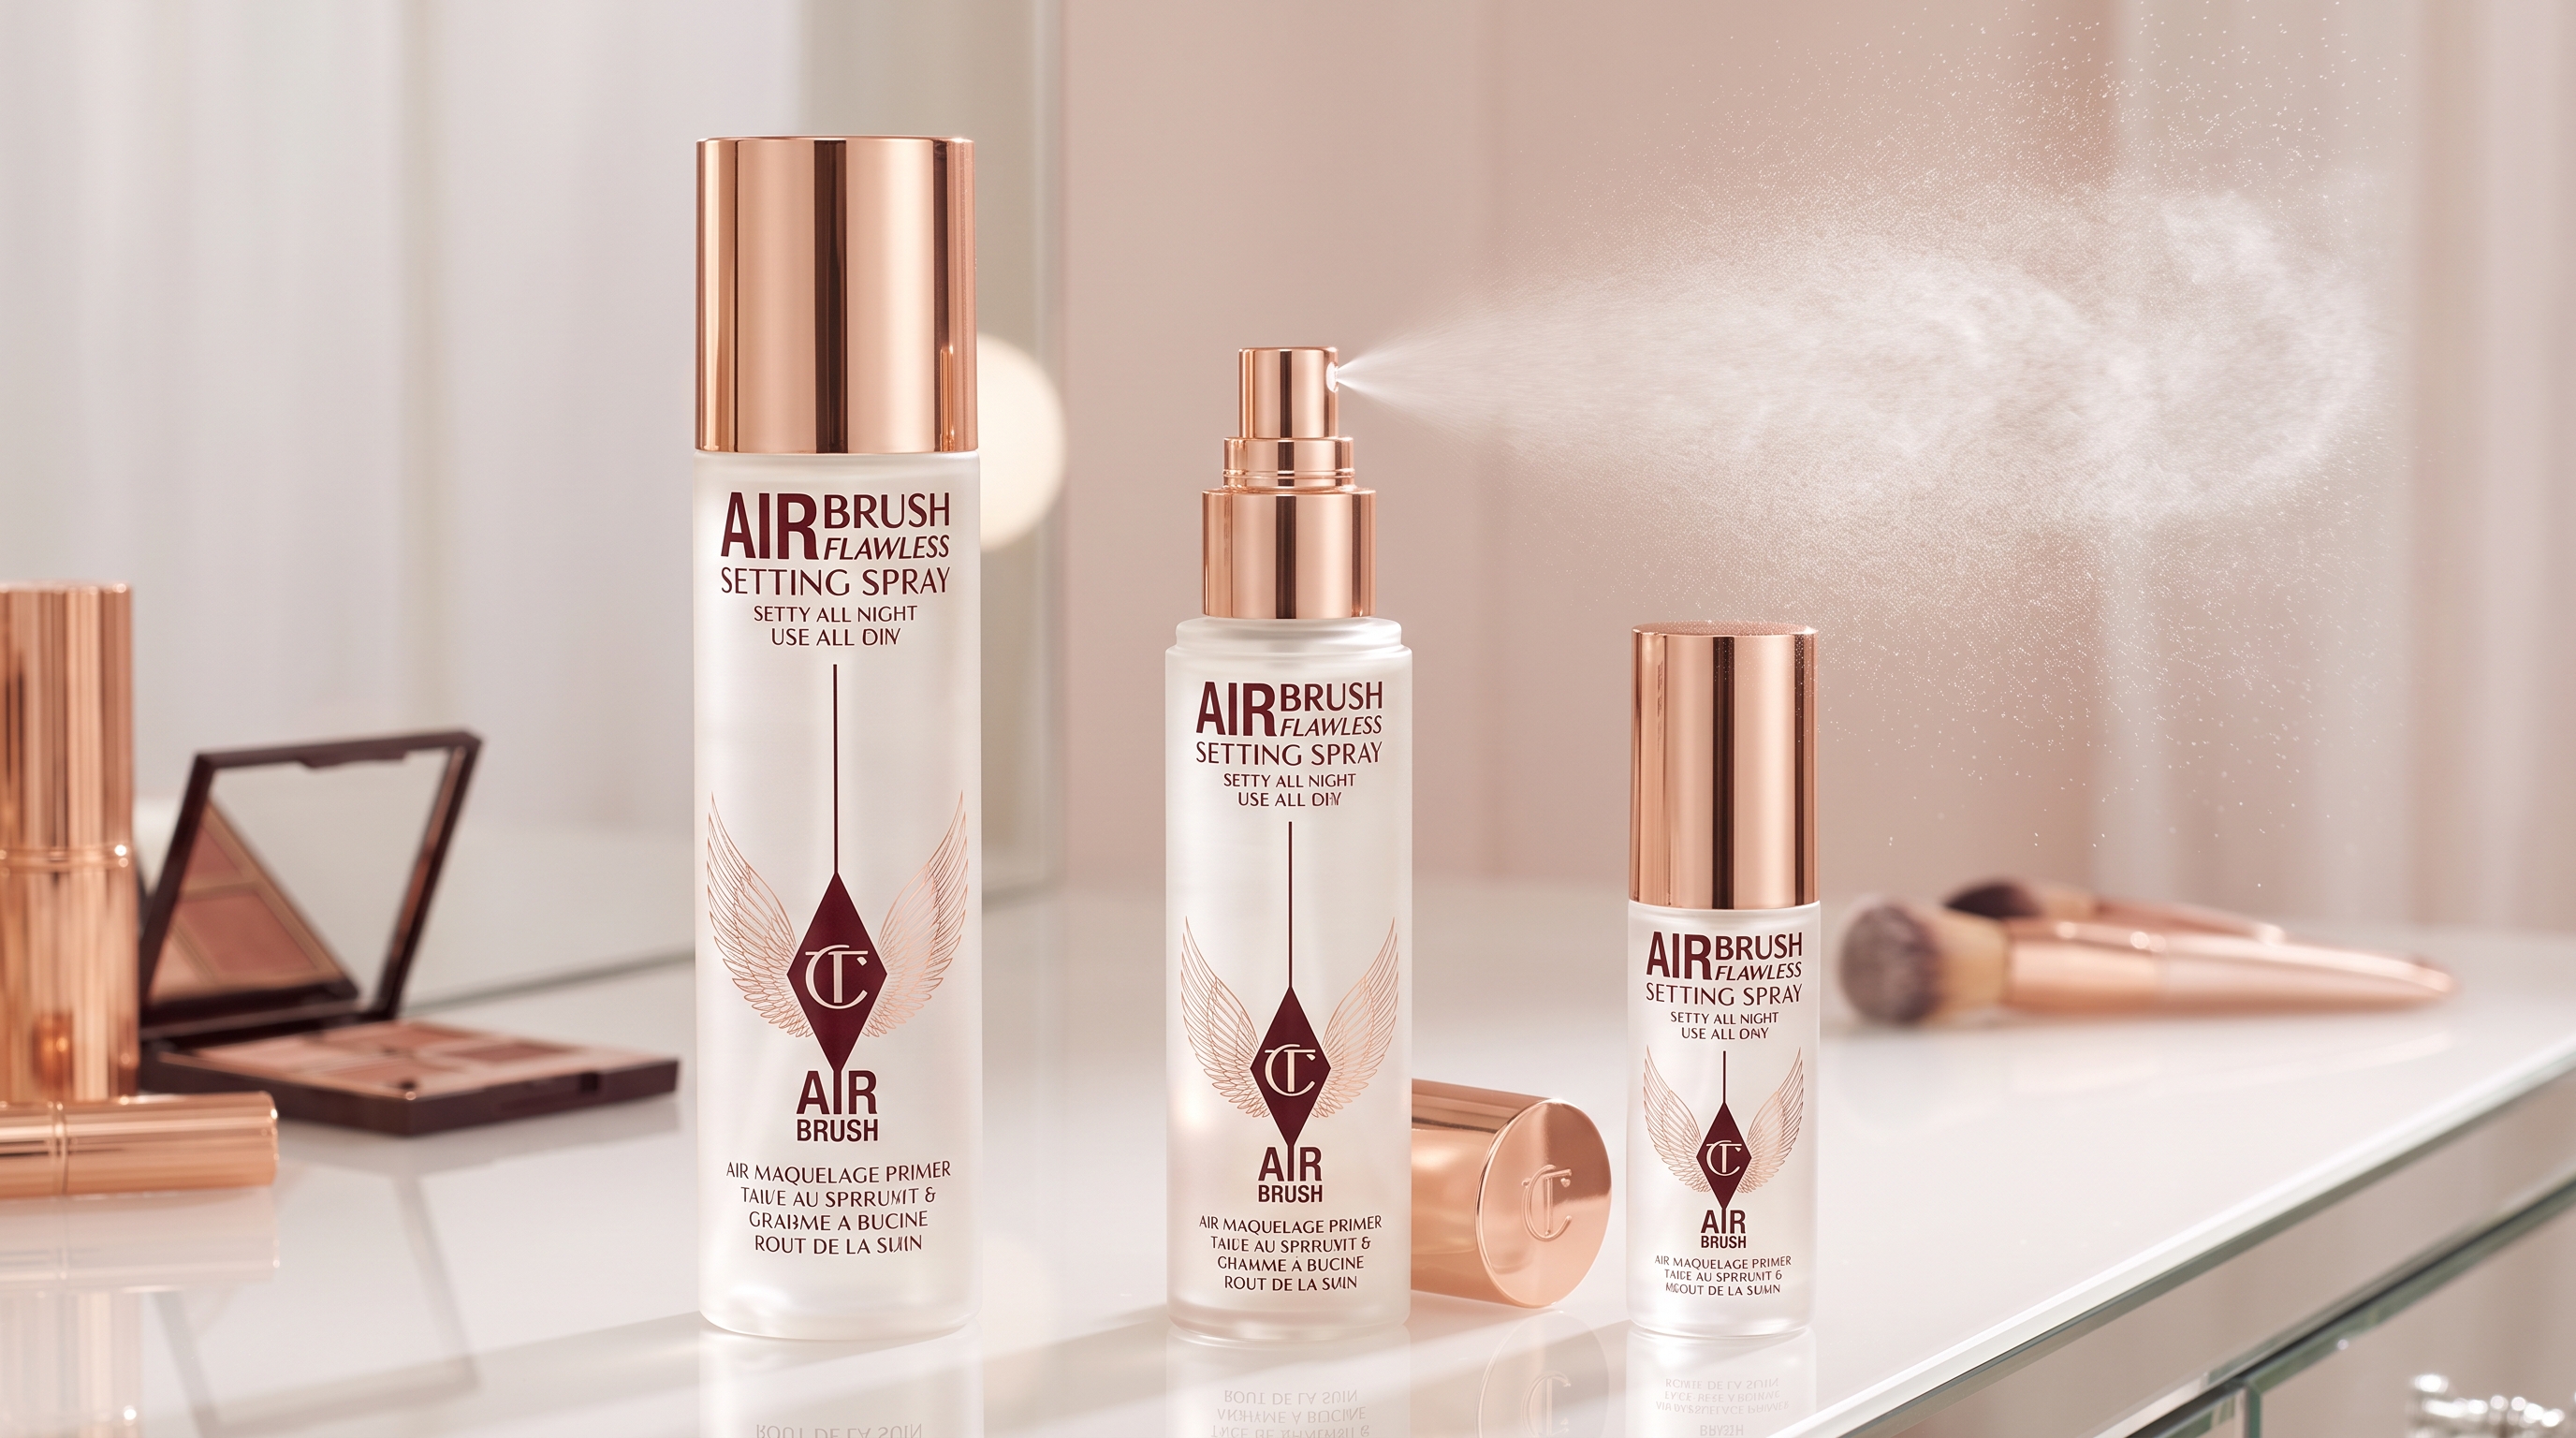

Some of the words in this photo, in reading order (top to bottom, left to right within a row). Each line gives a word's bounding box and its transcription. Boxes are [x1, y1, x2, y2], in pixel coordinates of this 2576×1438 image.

[824, 492, 949, 529] BRUSH
[824, 535, 949, 560] FLAWLESS
[722, 566, 849, 596] SETTING
[862, 566, 950, 595] SPRAY
[754, 606, 811, 622] SETTY
[816, 608, 852, 623] ALL
[858, 606, 917, 622] NIGHT
[772, 628, 810, 646] USE
[816, 629, 855, 646] ALL
[1281, 682, 1383, 712] BRUSH
[1280, 715, 1382, 737] FLAWLESS
[1196, 741, 1301, 766] SETTING
[1311, 741, 1383, 766] SPRAY
[1223, 773, 1271, 787] SETTY
[1276, 775, 1304, 787] ALL
[1310, 773, 1356, 787] NIGHT
[1238, 792, 1269, 806] USE
[1275, 793, 1306, 806] ALL
[1716, 932, 1802, 961] BRUSH
[1715, 961, 1802, 980] FLAWLESS
[1647, 982, 1734, 1005] SETTING
[1743, 983, 1802, 1005] SPRAY
[1671, 1011, 1709, 1024] SETTY
[1714, 1014, 1736, 1024] ALL
[1740, 1012, 1778, 1024] NIGHT
[1682, 1027, 1705, 1039] USE
[1711, 1029, 1735, 1040] ALL
[796, 1070, 878, 1115] AIR
[798, 1119, 878, 1142] BRUSH
[726, 1162, 749, 1179] AIR
[754, 1165, 879, 1186] MAQUELAGE
[886, 1161, 950, 1181] PRIMER
[1258, 1147, 1322, 1181] AIR
[793, 1192, 818, 1207] AU
[925, 1187, 936, 1202] &
[1258, 1184, 1323, 1203] BRUSH
[838, 1215, 851, 1230] A
[858, 1211, 928, 1230] BUCINE
[1199, 1215, 1219, 1229] AIR
[1223, 1218, 1325, 1236] MAQUELAGE
[1329, 1215, 1382, 1233] PRIMER
[1701, 1210, 1746, 1234] AIR
[755, 1235, 806, 1254] ROUT
[814, 1239, 839, 1255] DE
[846, 1239, 871, 1255] LA
[1254, 1240, 1275, 1253] AU
[1361, 1237, 1370, 1249] &
[1701, 1236, 1746, 1249] BRUSH
[1308, 1255, 1364, 1271] BUCINE
[1655, 1255, 1669, 1265] AIR
[1674, 1257, 1749, 1270] MAQUELAGE
[1752, 1255, 1791, 1269] PRIMER
[1225, 1276, 1266, 1290] ROUT
[1272, 1278, 1293, 1291] DE
[1298, 1278, 1317, 1291] LA
[1696, 1272, 1711, 1282] AU
[1708, 1285, 1723, 1296] DE
[1728, 1286, 1743, 1296] LA
